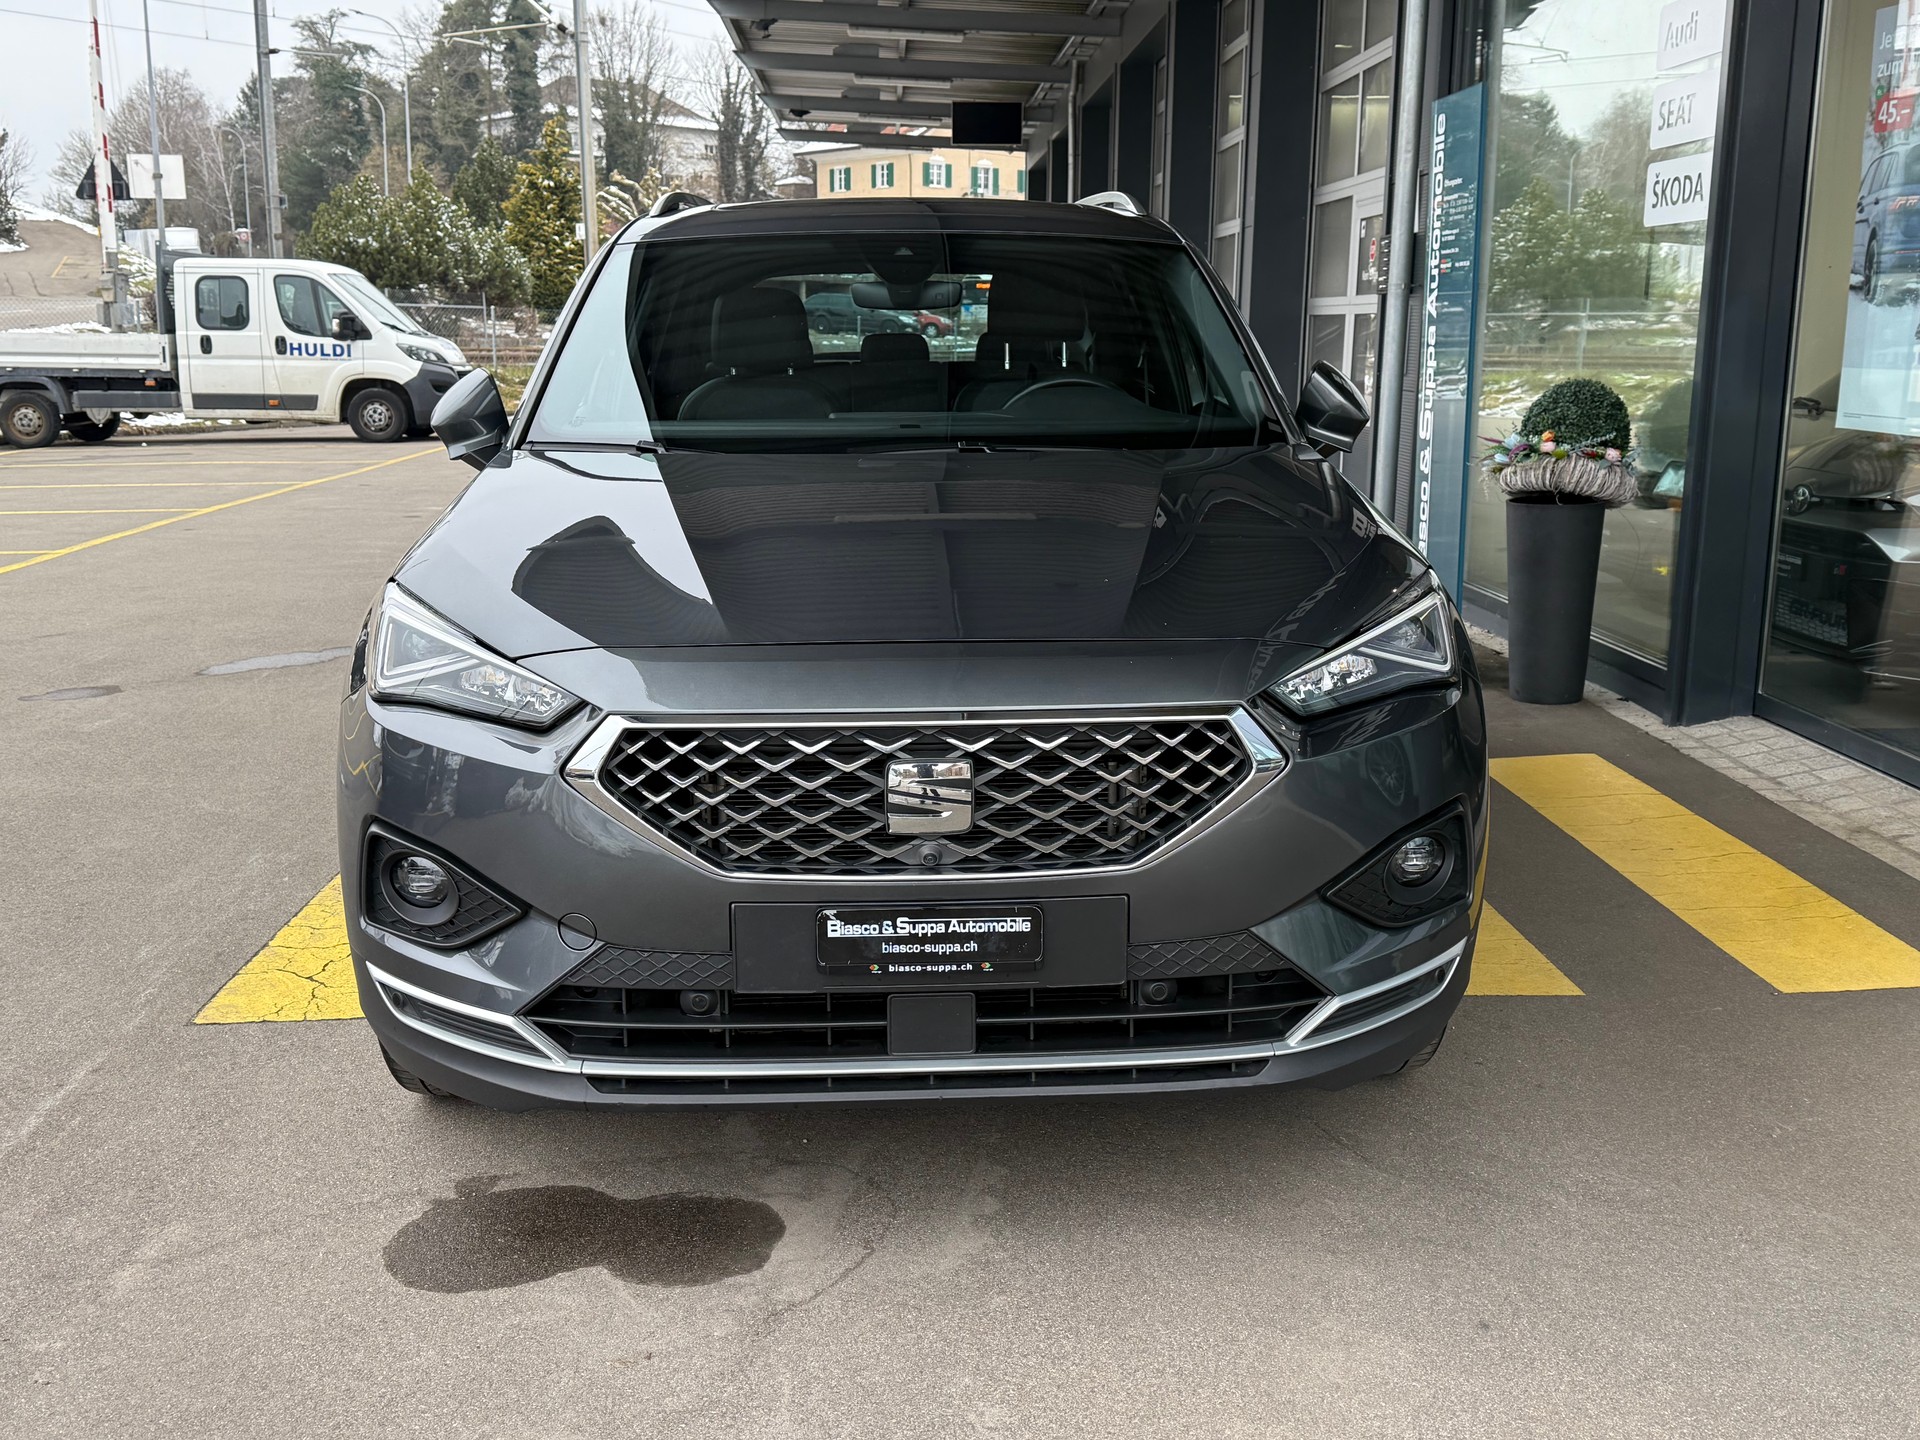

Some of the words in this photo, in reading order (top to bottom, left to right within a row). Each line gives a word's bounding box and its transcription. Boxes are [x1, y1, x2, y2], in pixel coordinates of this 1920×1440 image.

[1664, 10, 1699, 50] Audi
[1658, 92, 1697, 131] SEAT
[1651, 172, 1704, 209] ŠKODA
[1426, 112, 1447, 318] Automobile
[289, 342, 352, 358] HULDI
[1419, 325, 1437, 441] Suppa
[1419, 446, 1430, 475] &
[827, 919, 879, 937] Biasco
[881, 920, 895, 934] &
[896, 916, 945, 937] Suppa
[948, 917, 1032, 934] Automobile
[881, 940, 978, 955] biasco-suppa.ch
[888, 963, 973, 973] biasco-suppa.ch
